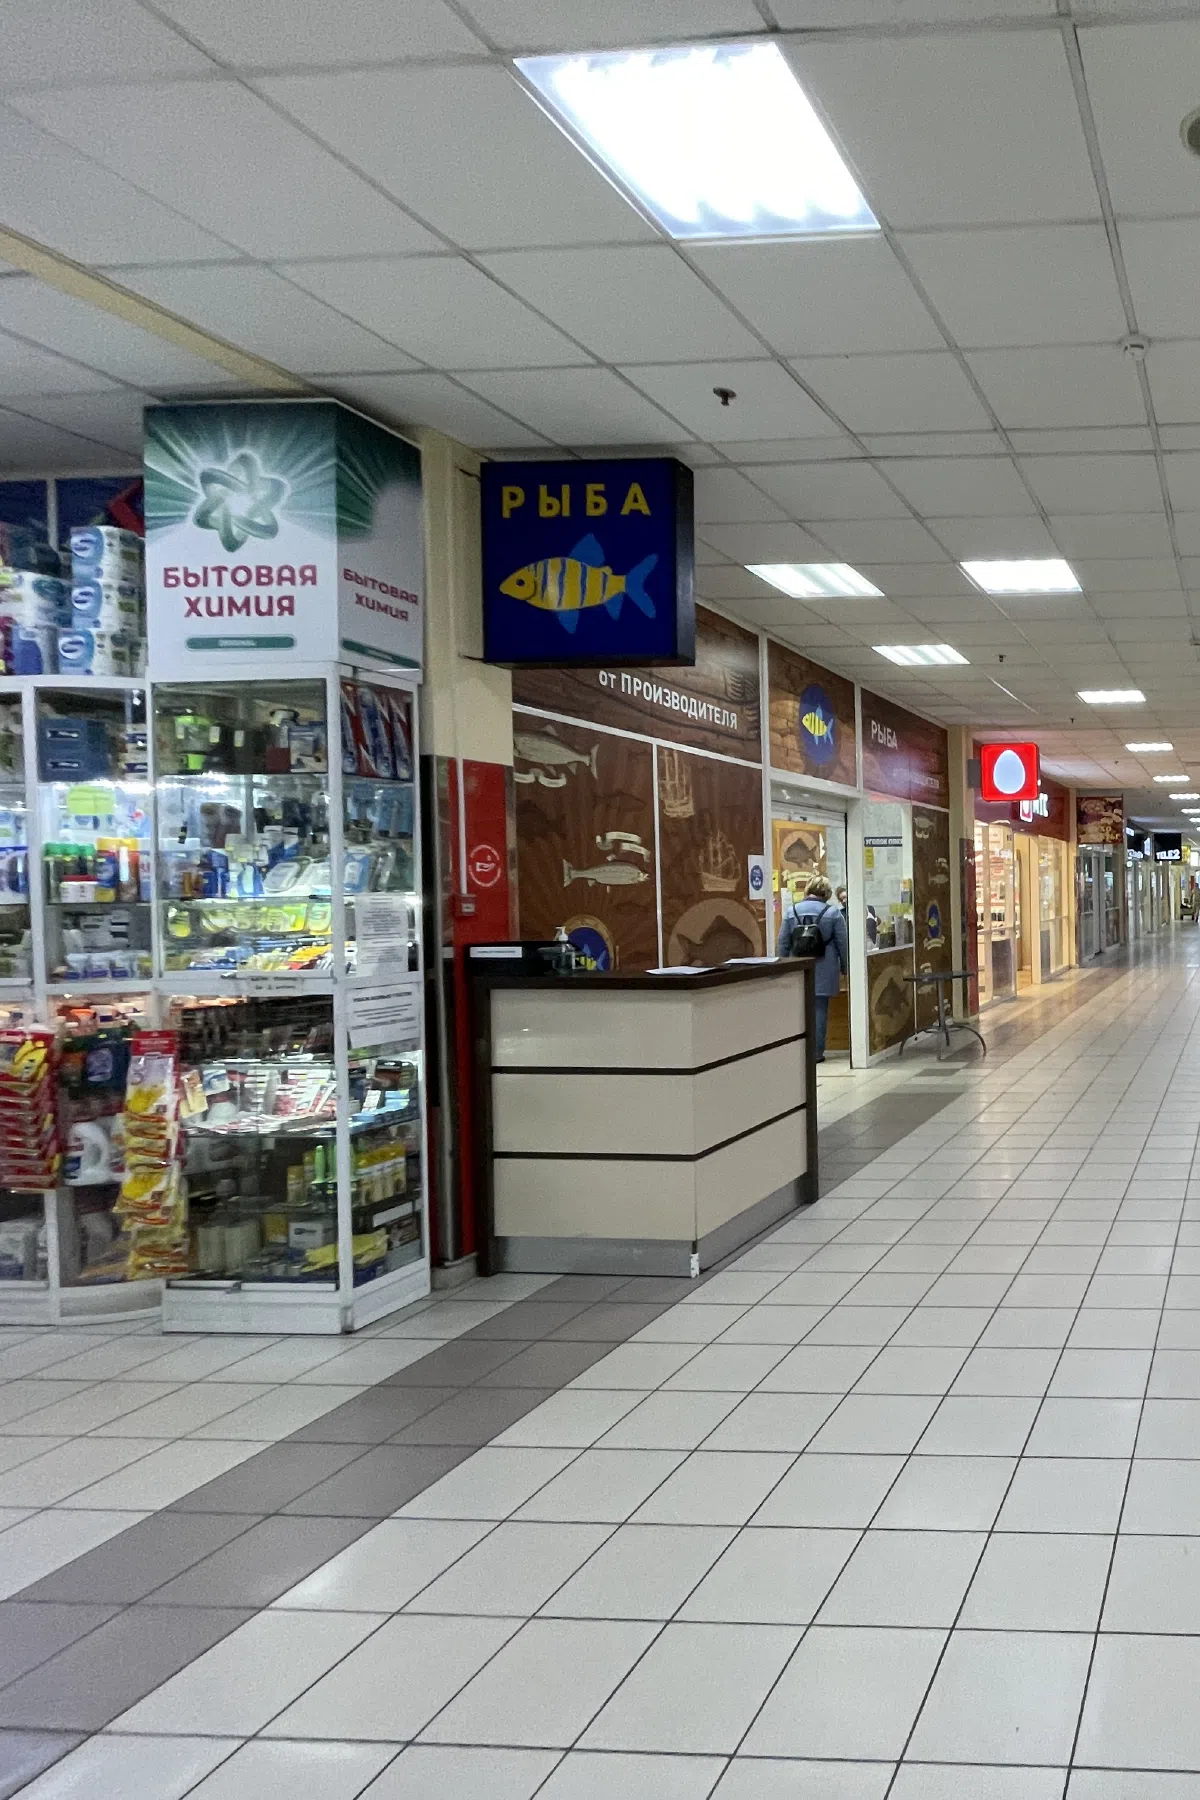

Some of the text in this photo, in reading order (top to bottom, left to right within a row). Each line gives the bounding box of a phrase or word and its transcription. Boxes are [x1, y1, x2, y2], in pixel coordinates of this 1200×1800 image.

[502, 482, 651, 519] РЫБА
[163, 564, 317, 588] БЫТОВАЯ
[343, 568, 419, 606] БЫТОВАЯ
[184, 595, 295, 618] ХИМИЯ
[355, 592, 409, 622] ХИМИЯ
[599, 670, 738, 730] от ПРОИЗВОДИТЕЛЯ
[871, 719, 898, 750] РЫБА
[1156, 849, 1180, 860] TELE2
